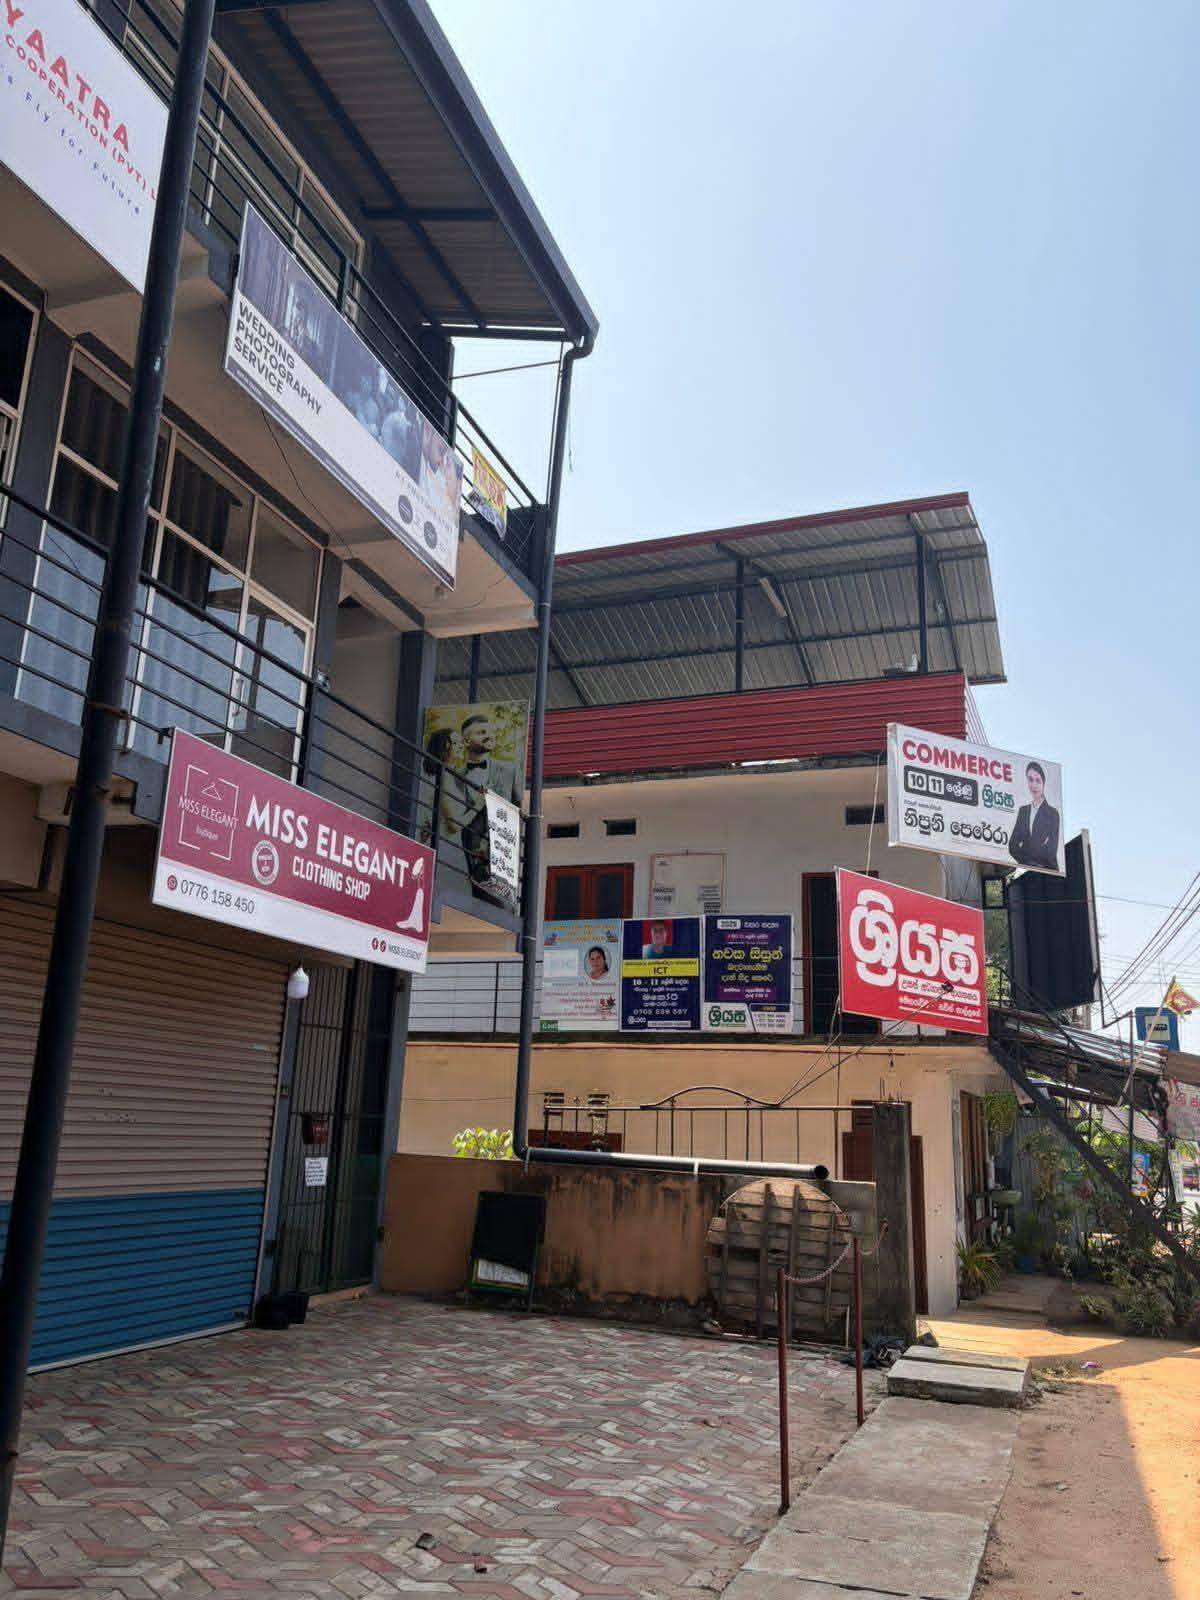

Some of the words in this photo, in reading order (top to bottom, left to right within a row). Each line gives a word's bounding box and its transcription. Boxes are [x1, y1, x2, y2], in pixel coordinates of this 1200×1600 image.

[5, 34, 108, 148] COOPERATION
[111, 147, 146, 192] (PVT)
[239, 300, 295, 369] WEDDING
[234, 336, 284, 395] SERVICE
[236, 318, 322, 415] PHOTOGRAPHY
[902, 739, 1013, 783] COMMERCE
[910, 774, 925, 788] 10
[931, 778, 942, 792] 11
[245, 795, 309, 849] MISS
[316, 823, 409, 888] ELEGANT
[180, 879, 209, 899] 0776
[211, 890, 232, 908] 158
[234, 898, 255, 914] 450
[292, 855, 342, 892] CLOTHING
[345, 876, 371, 901] SHOP
[653, 966, 668, 975] ICT
